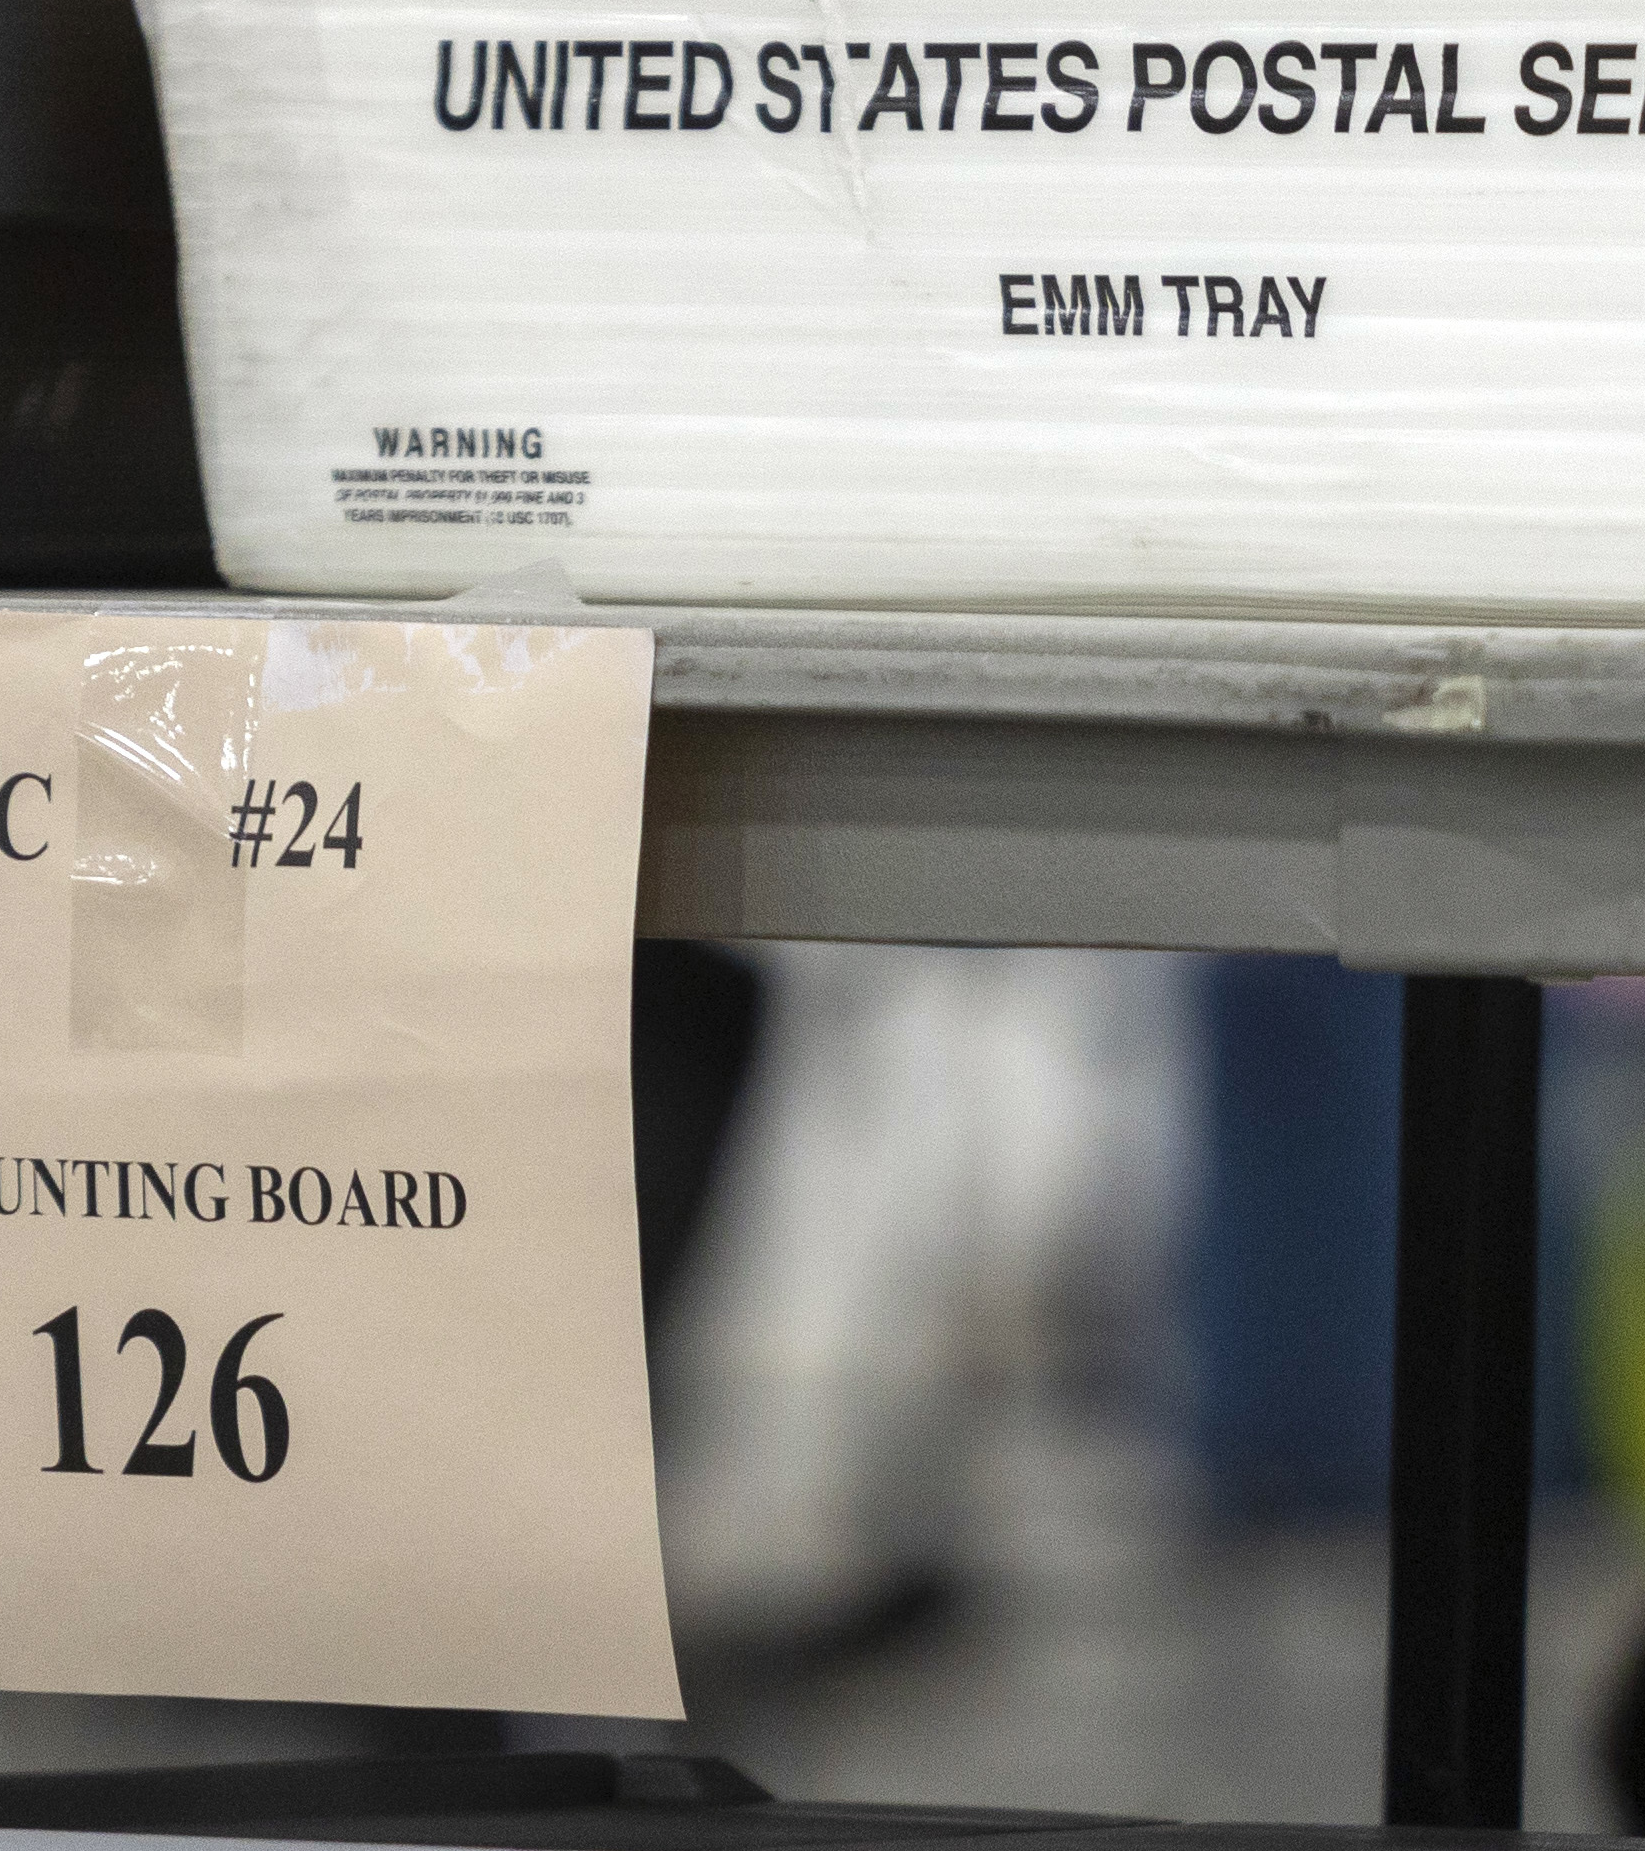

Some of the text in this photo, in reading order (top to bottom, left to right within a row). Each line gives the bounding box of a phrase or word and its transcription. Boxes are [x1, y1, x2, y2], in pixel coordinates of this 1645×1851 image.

[435, 41, 733, 131] UNITED
[756, 41, 1099, 133] STATES
[1127, 41, 1485, 135] POSTAL
[1000, 274, 1326, 337] EMM TRAY
[374, 428, 542, 459] WARNING
[448, 469, 475, 483] FOR
[478, 469, 516, 483] THEFT
[521, 470, 539, 484] OR
[230, 780, 362, 869] #24
[249, 1166, 466, 1228] BOARD
[33, 1306, 289, 1483] 126
